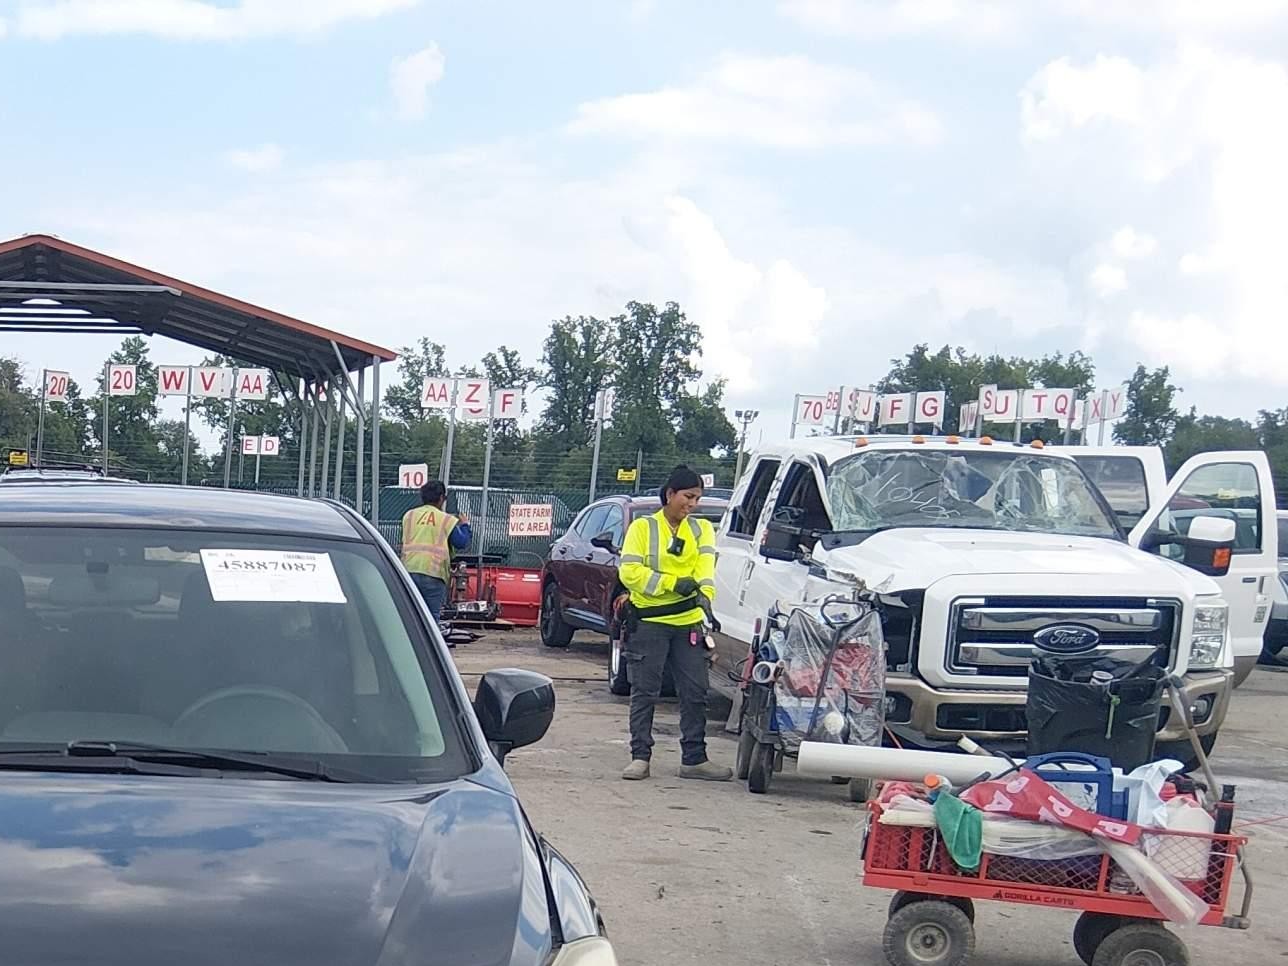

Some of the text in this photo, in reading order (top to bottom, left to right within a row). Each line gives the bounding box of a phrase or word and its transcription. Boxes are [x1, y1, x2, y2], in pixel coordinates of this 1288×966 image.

[49, 376, 66, 396] 20
[112, 370, 133, 390] 20
[162, 371, 185, 391] W
[200, 372, 216, 391] V
[240, 374, 263, 394] AA
[425, 383, 448, 403] AA
[465, 384, 481, 403] Z
[984, 390, 992, 410] S
[1112, 392, 1120, 413] Y
[501, 394, 514, 413] F
[803, 400, 823, 421] 70
[862, 396, 872, 415] J
[890, 399, 903, 419] F
[922, 397, 938, 417] G
[995, 395, 1009, 415] U
[1032, 395, 1047, 413] T
[1054, 394, 1068, 415] Q
[1092, 397, 1101, 418] X
[245, 439, 254, 451] E
[265, 440, 274, 451] D
[403, 472, 424, 487] 10
[511, 508, 551, 518] STATE FARM
[511, 522, 549, 532] VIC AREA
[218, 560, 317, 573] 45887087
[1050, 629, 1087, 645] Ford
